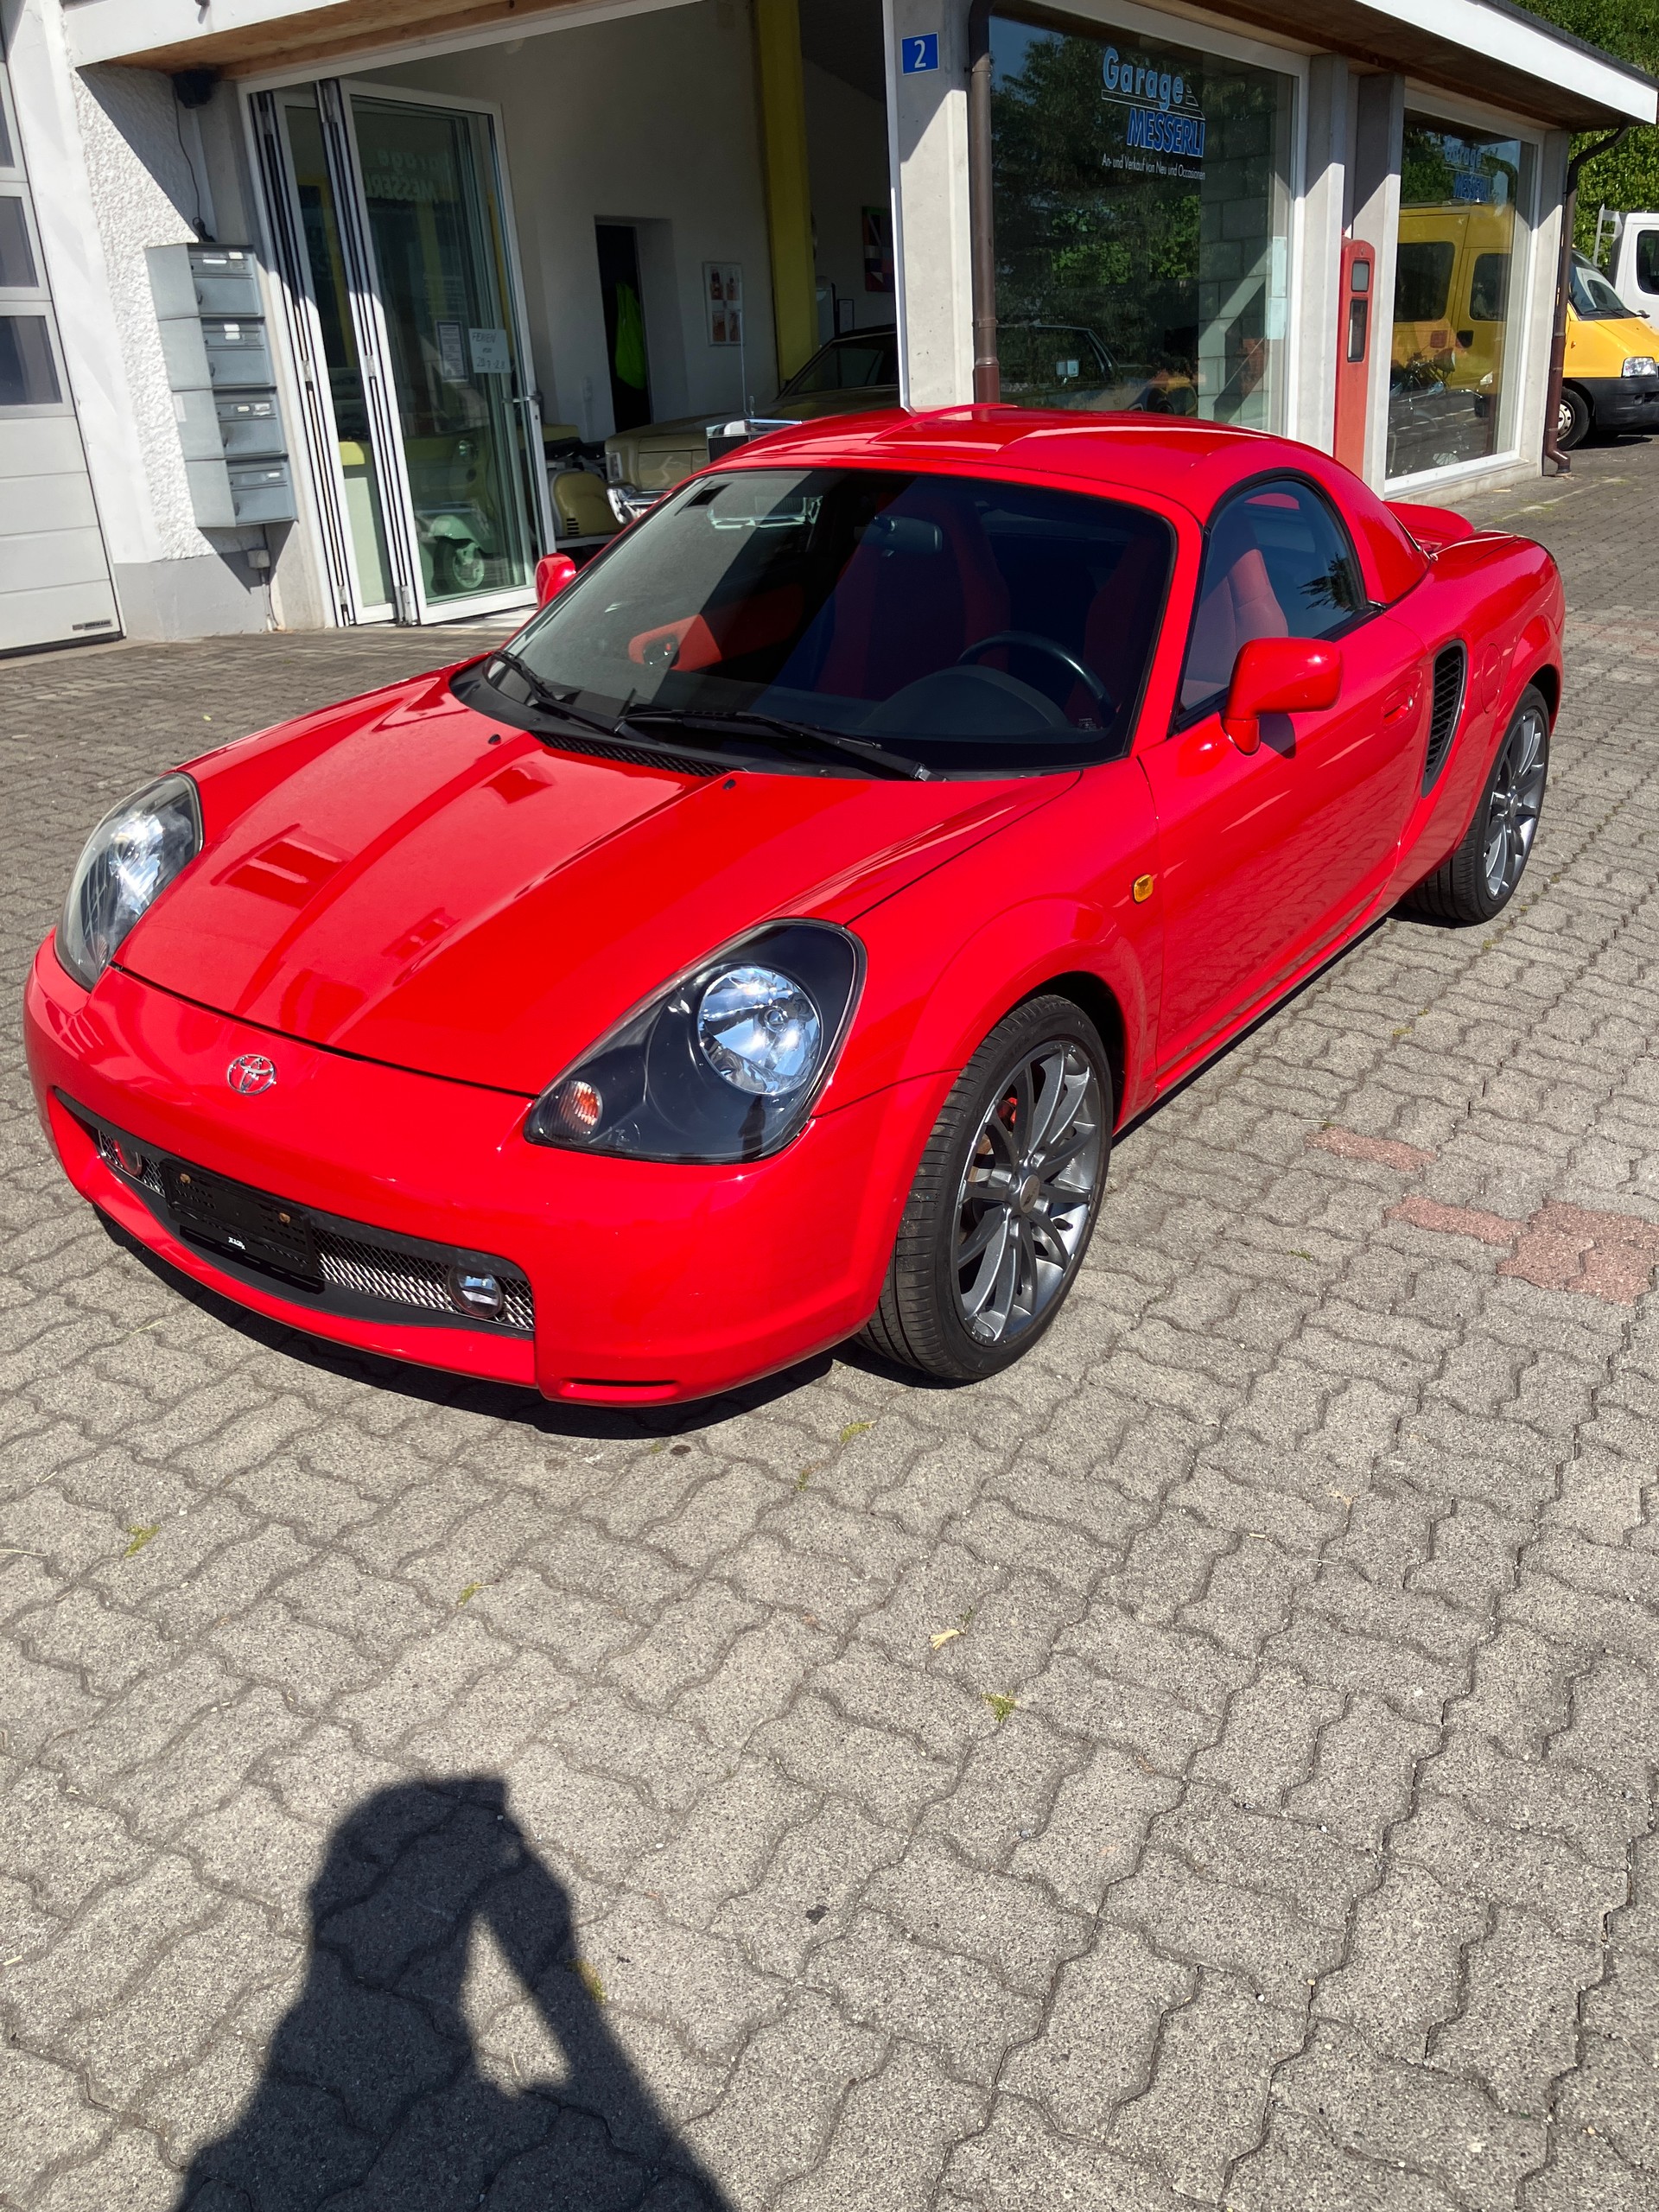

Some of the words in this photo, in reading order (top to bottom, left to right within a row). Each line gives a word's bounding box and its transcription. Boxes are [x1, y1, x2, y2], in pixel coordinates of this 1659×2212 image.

[914, 40, 926, 68] 2
[1103, 48, 1184, 111] Garage
[1127, 107, 1205, 158] MESSERLI
[1113, 154, 1123, 168] und
[1124, 156, 1146, 172] Verkauf
[1156, 161, 1166, 175] Neu
[1167, 162, 1178, 176] und
